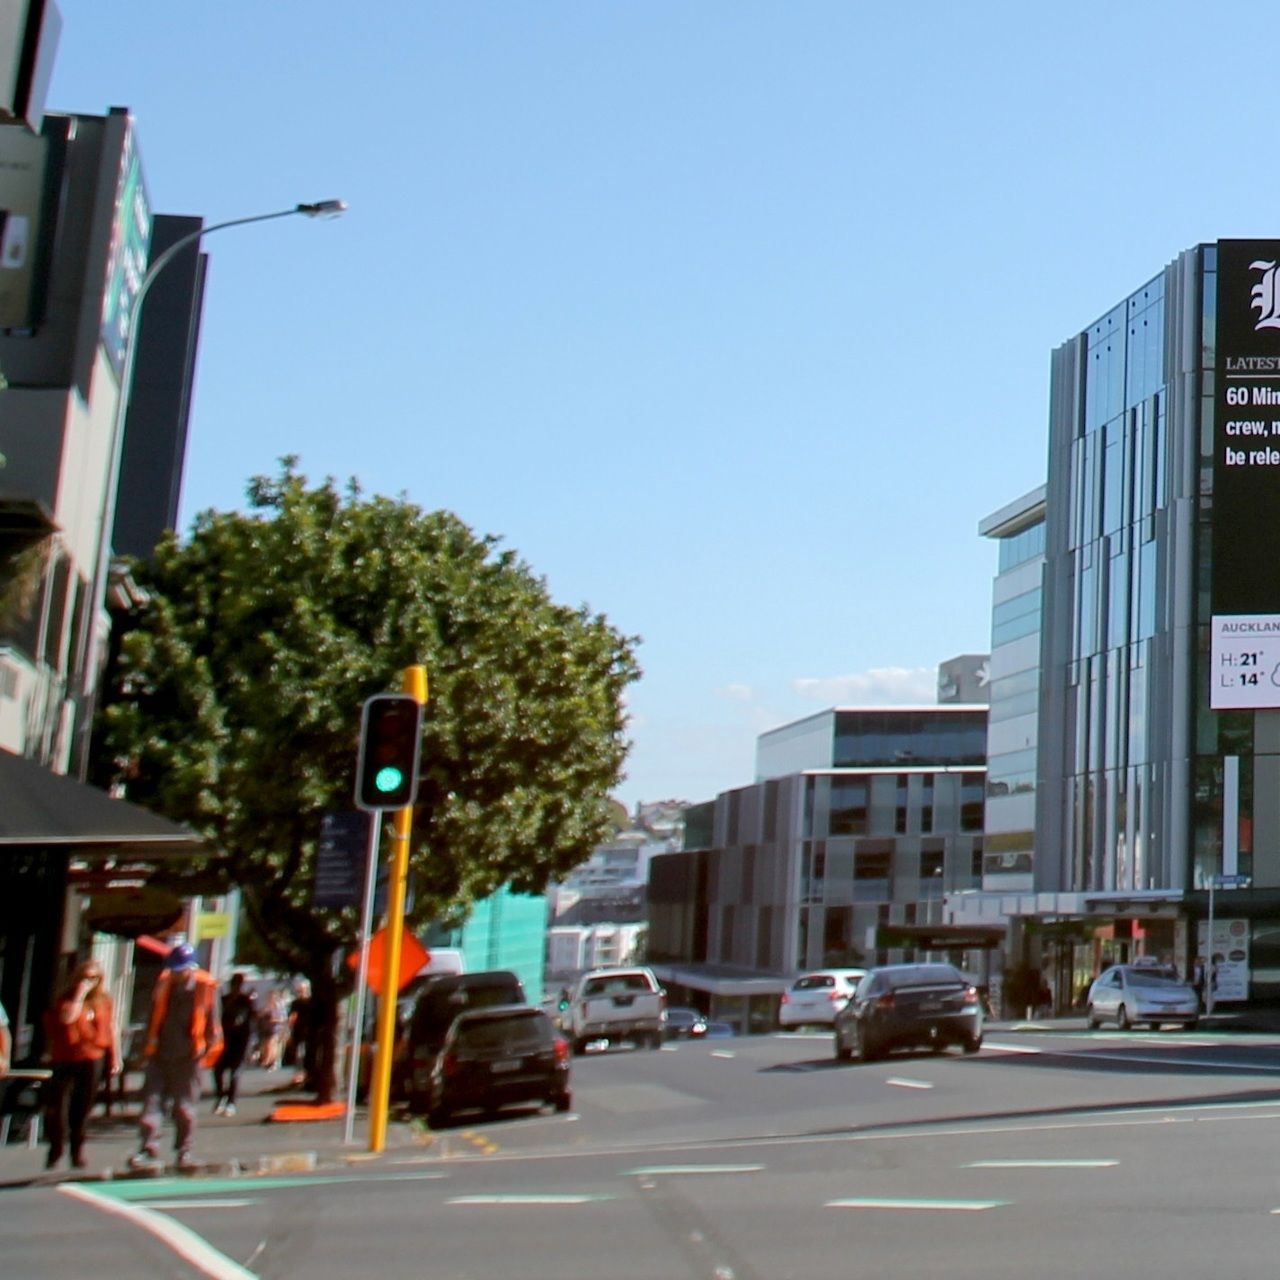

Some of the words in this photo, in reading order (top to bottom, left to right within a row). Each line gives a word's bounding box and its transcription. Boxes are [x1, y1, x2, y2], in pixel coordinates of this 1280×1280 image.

[1226, 387, 1249, 406] 60
[1225, 420, 1269, 438] crew,
[1225, 446, 1246, 465] be
[1221, 652, 1238, 667] H:
[1221, 674, 1235, 687] L:
